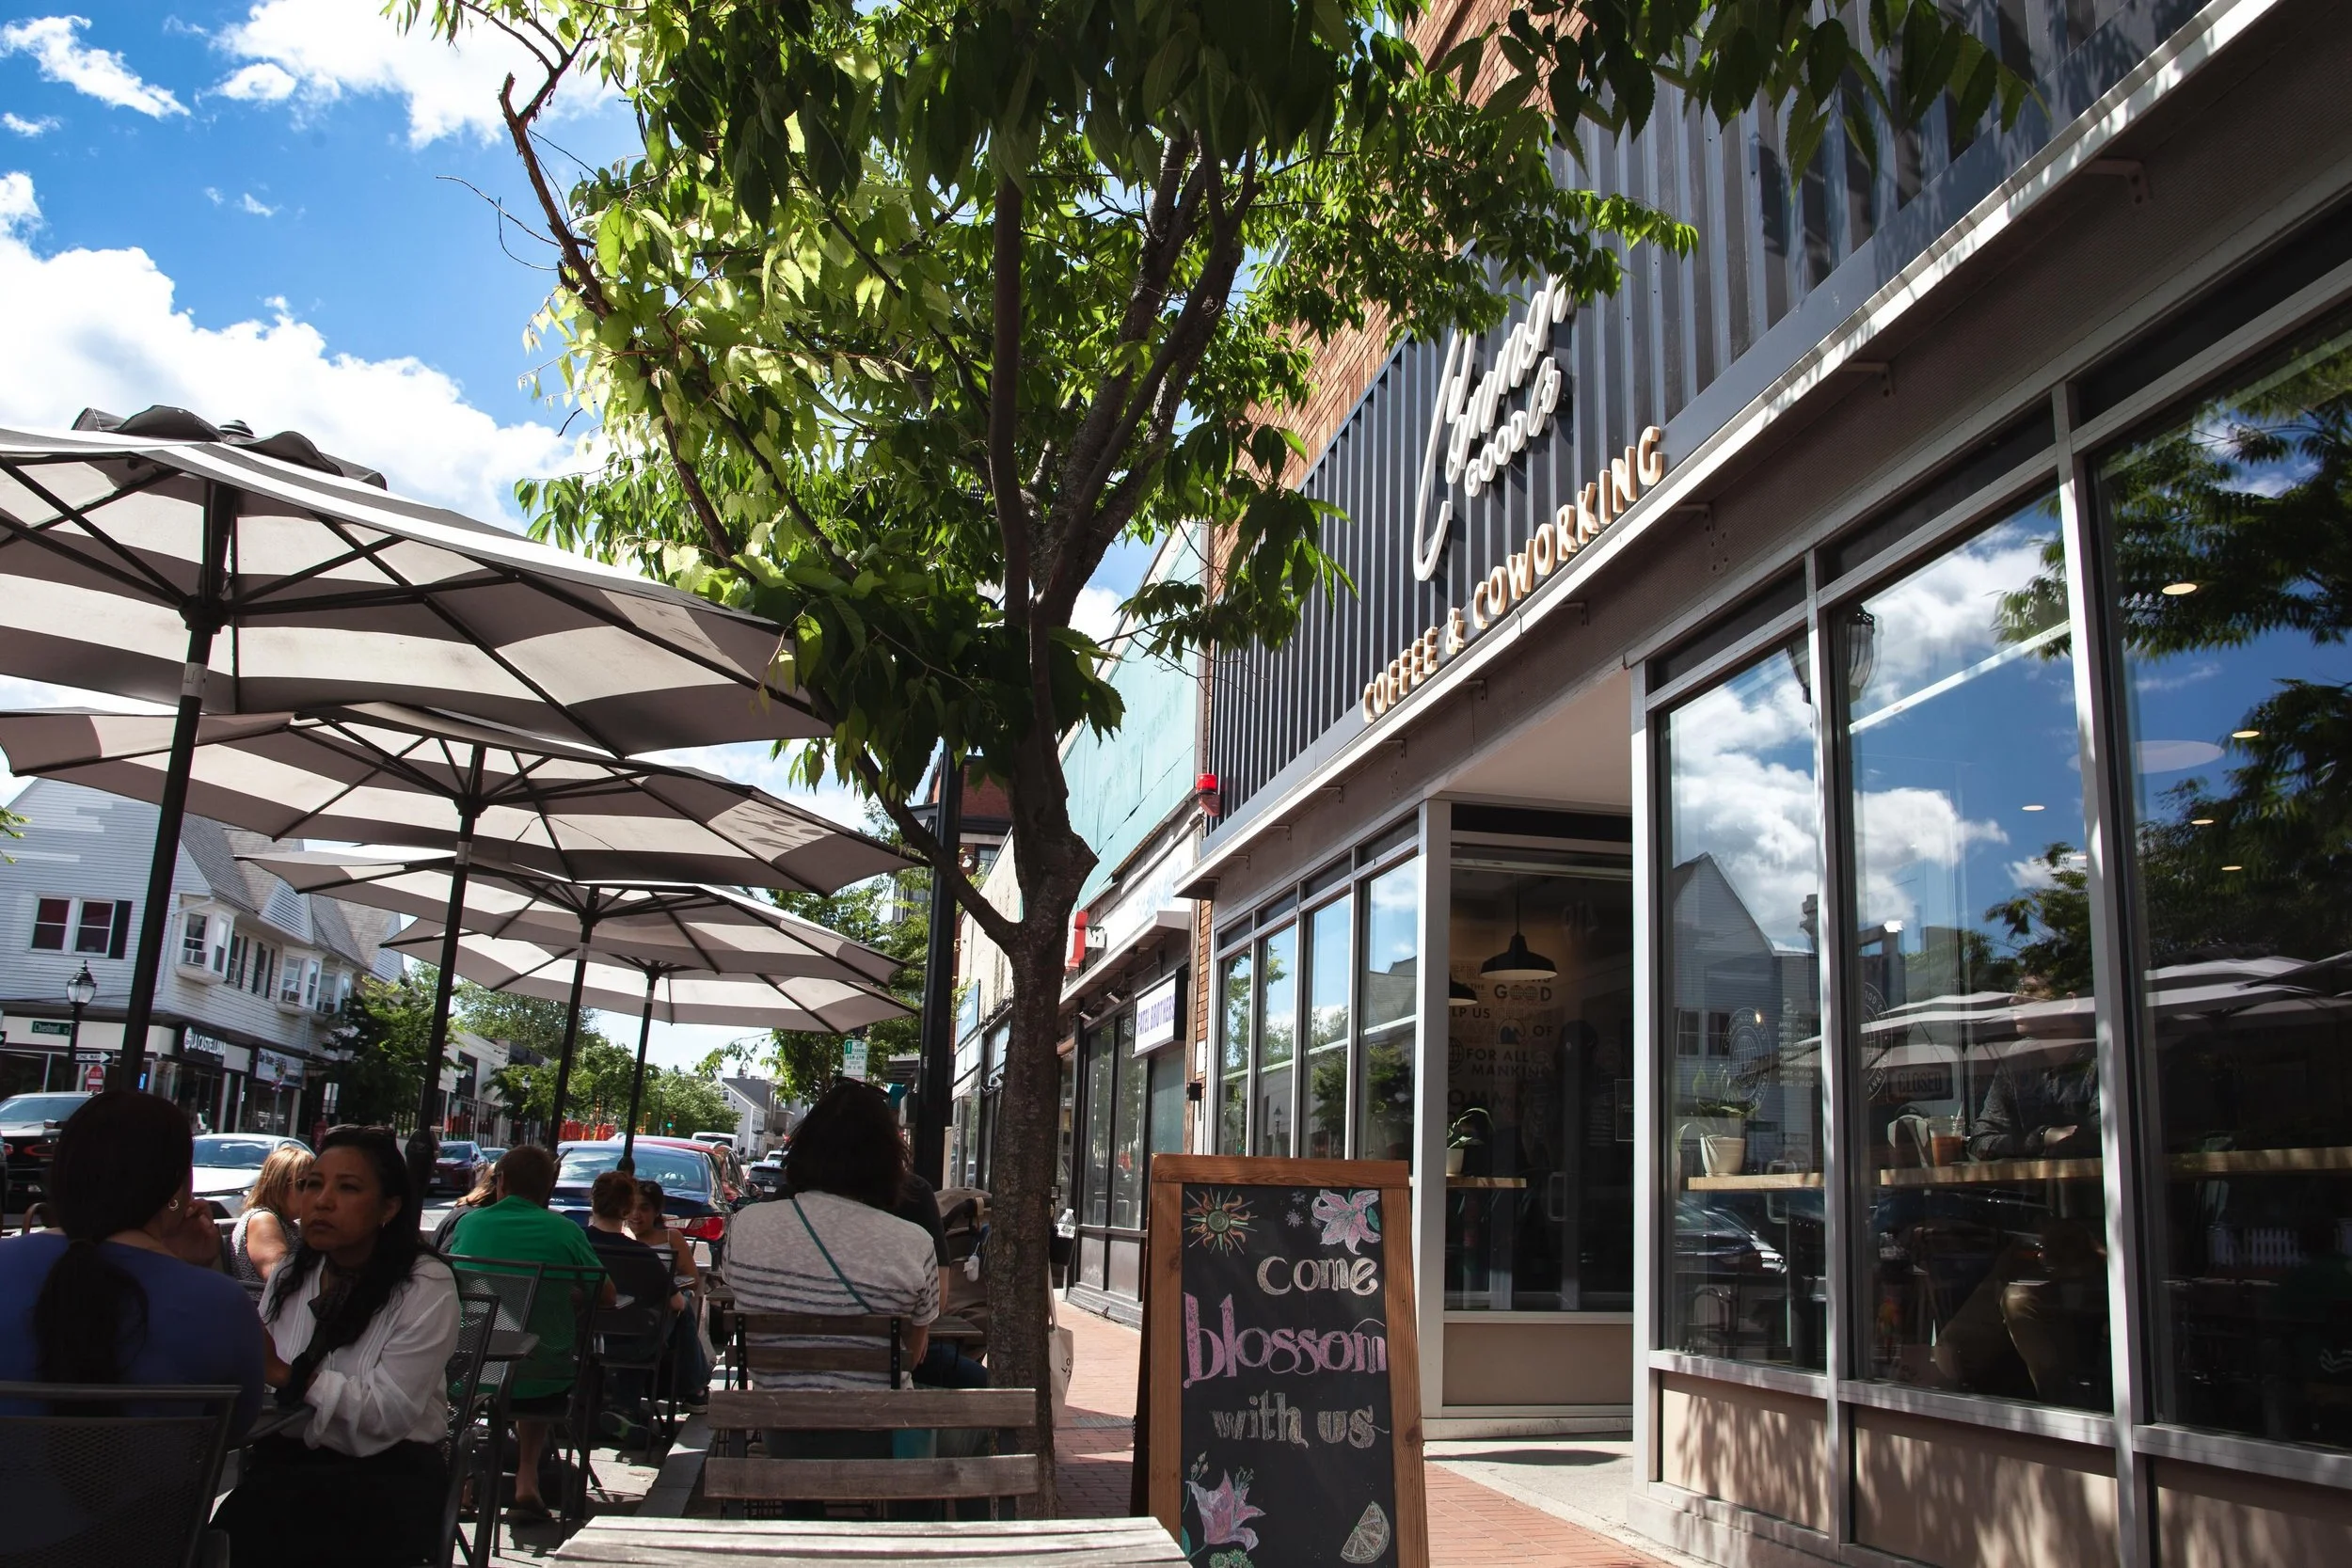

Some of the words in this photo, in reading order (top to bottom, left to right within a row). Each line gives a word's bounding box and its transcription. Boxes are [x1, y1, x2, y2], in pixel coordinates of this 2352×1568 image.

[1363, 626, 1438, 722] COFFEE
[1445, 608, 1465, 655] &
[1473, 426, 1663, 629] COWORKING
[1494, 984, 1552, 1002] GOOD
[1472, 1008, 1490, 1019] US
[34, 1022, 60, 1034] Chestnut
[1533, 1025, 1553, 1037] OF
[191, 1033, 198, 1050] LA
[198, 1035, 226, 1056] CASTELLANA
[1466, 1048, 1497, 1061] FOR
[1502, 1050, 1529, 1063] ALL
[1899, 1072, 1942, 1092] CLOSED
[1184, 1291, 1387, 1389] blossom
[1211, 1390, 1309, 1449] with
[1317, 1405, 1390, 1449] us
